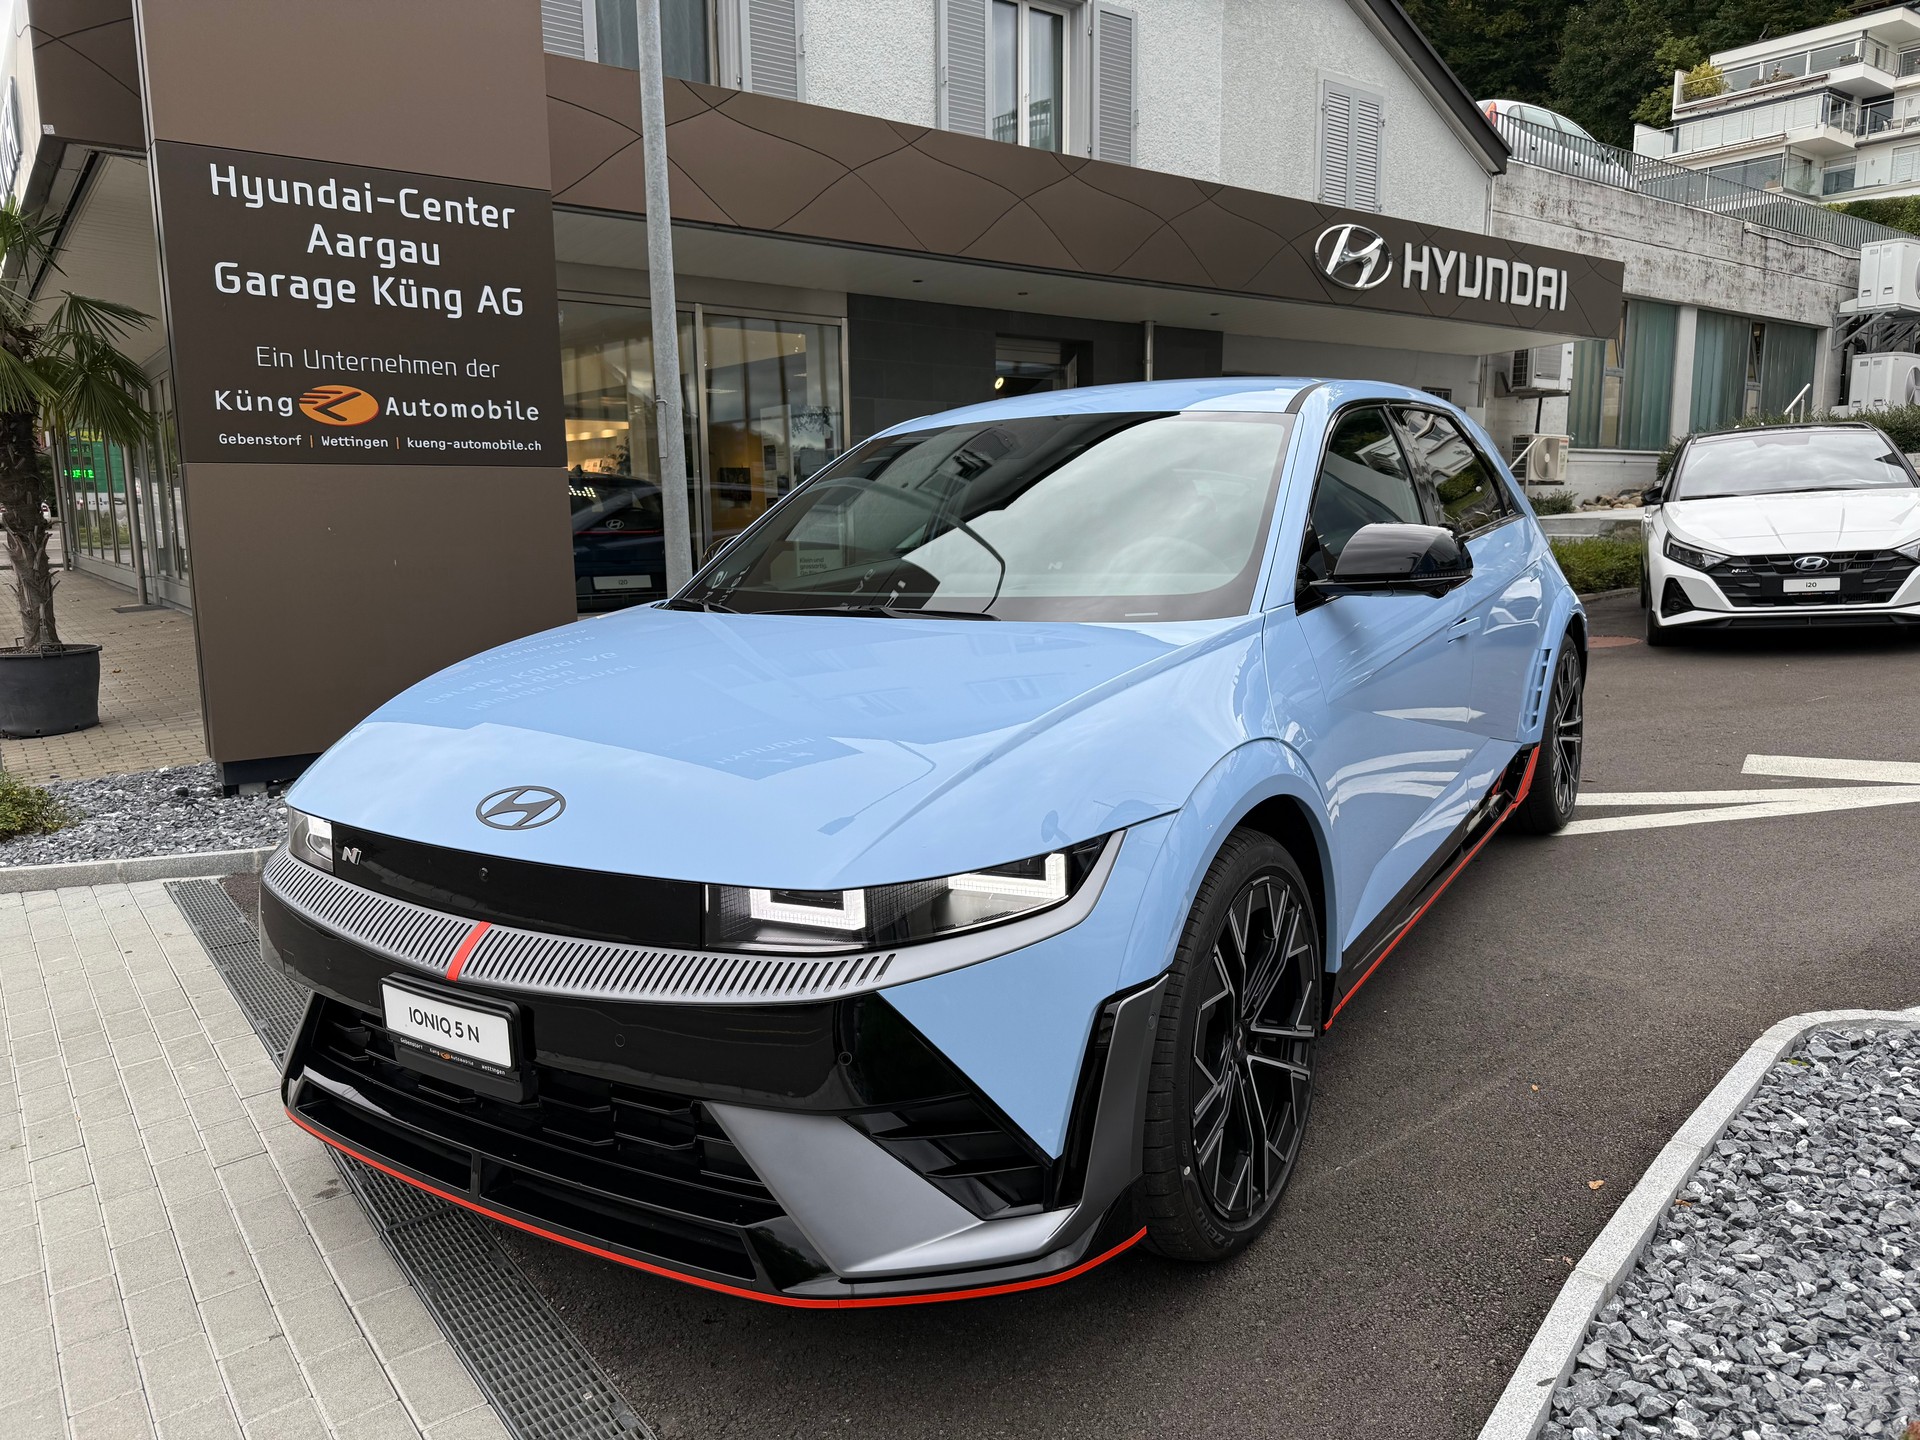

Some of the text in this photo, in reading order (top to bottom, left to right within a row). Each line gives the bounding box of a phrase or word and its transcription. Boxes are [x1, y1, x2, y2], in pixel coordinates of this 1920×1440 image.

[209, 163, 515, 229] Hyundai-Center
[306, 223, 441, 269] Aargau
[214, 261, 524, 319] Garage Küng AG
[1402, 242, 1568, 312] HYUNDAI
[256, 345, 500, 378] Ein Unternehmen der
[214, 389, 540, 422] Küng Automobile
[218, 433, 542, 452] Gebenstorf Wettingen kueng-automobile.ch
[408, 1006, 480, 1043] IONIQ 5 N
